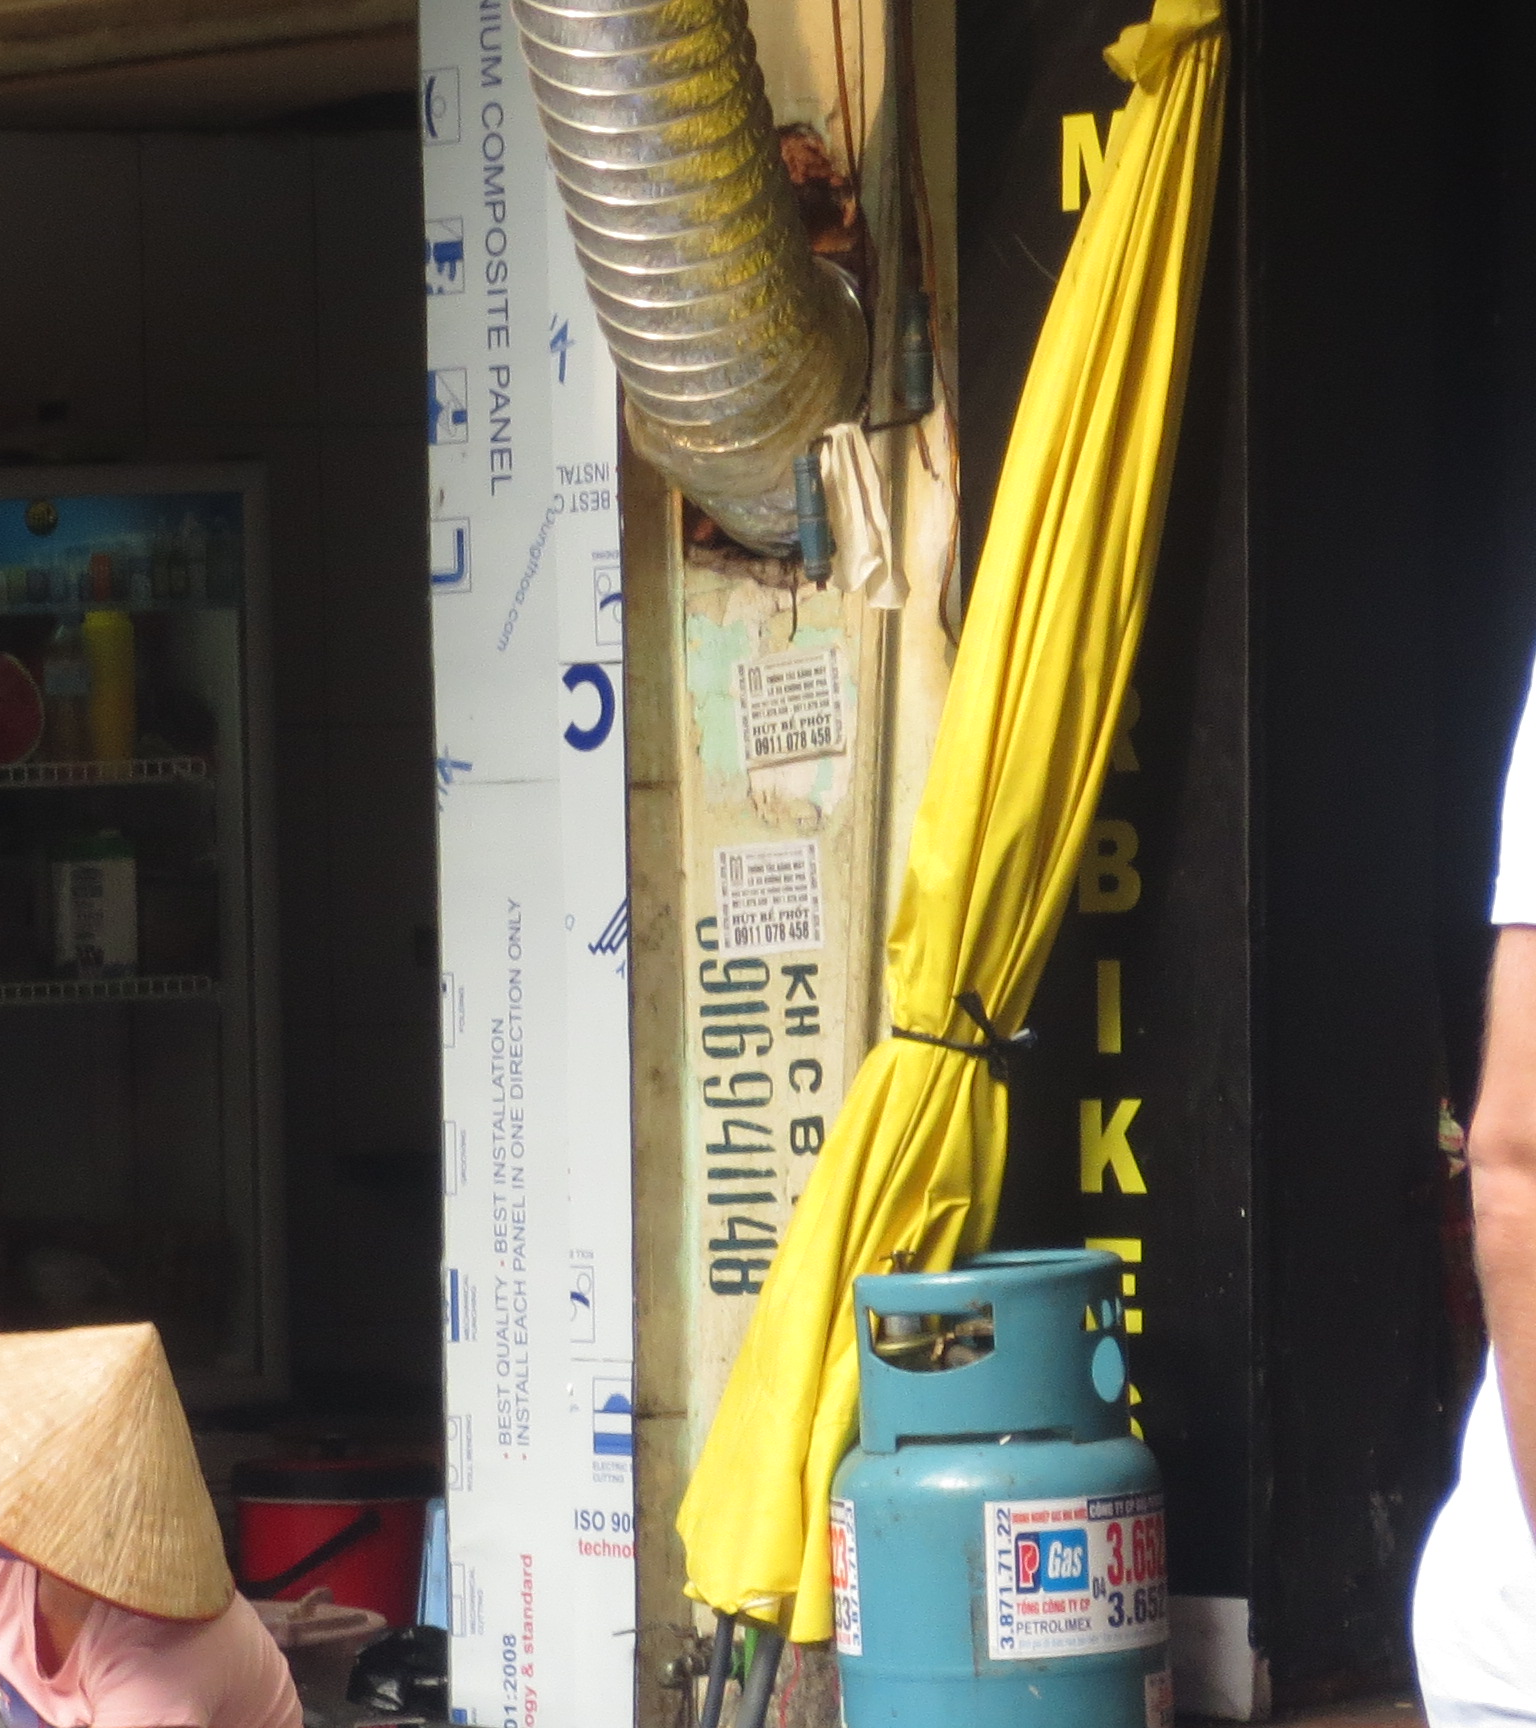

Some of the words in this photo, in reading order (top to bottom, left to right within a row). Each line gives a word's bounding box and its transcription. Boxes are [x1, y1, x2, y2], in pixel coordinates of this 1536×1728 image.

[482, 101, 512, 351] COMPOSITE
[489, 365, 513, 497] PANEL
[754, 735, 782, 756] 0911
[786, 731, 807, 751] 078
[811, 726, 831, 746] 458
[507, 897, 524, 962] ONLY
[734, 925, 761, 945] 0911
[765, 922, 786, 942] 078
[789, 920, 809, 940] 458
[509, 964, 525, 1101] DIRECTION
[490, 1017, 508, 1188] INSTALLATION
[510, 1106, 526, 1160] ONE
[511, 1164, 526, 1188] IN
[493, 1193, 508, 1255] BEST
[511, 1193, 527, 1274] PANEL
[496, 1275, 511, 1379] QUALITY
[513, 1276, 528, 1343] EACH
[498, 1385, 513, 1447] BEST
[515, 1345, 530, 1447] INSTALL
[574, 1508, 606, 1532] ISO
[996, 1507, 1015, 1650] 3.871.71.22
[1047, 1540, 1083, 1580] Gas
[520, 1553, 534, 1655] standard
[1015, 1616, 1093, 1636] PETROLIMEX
